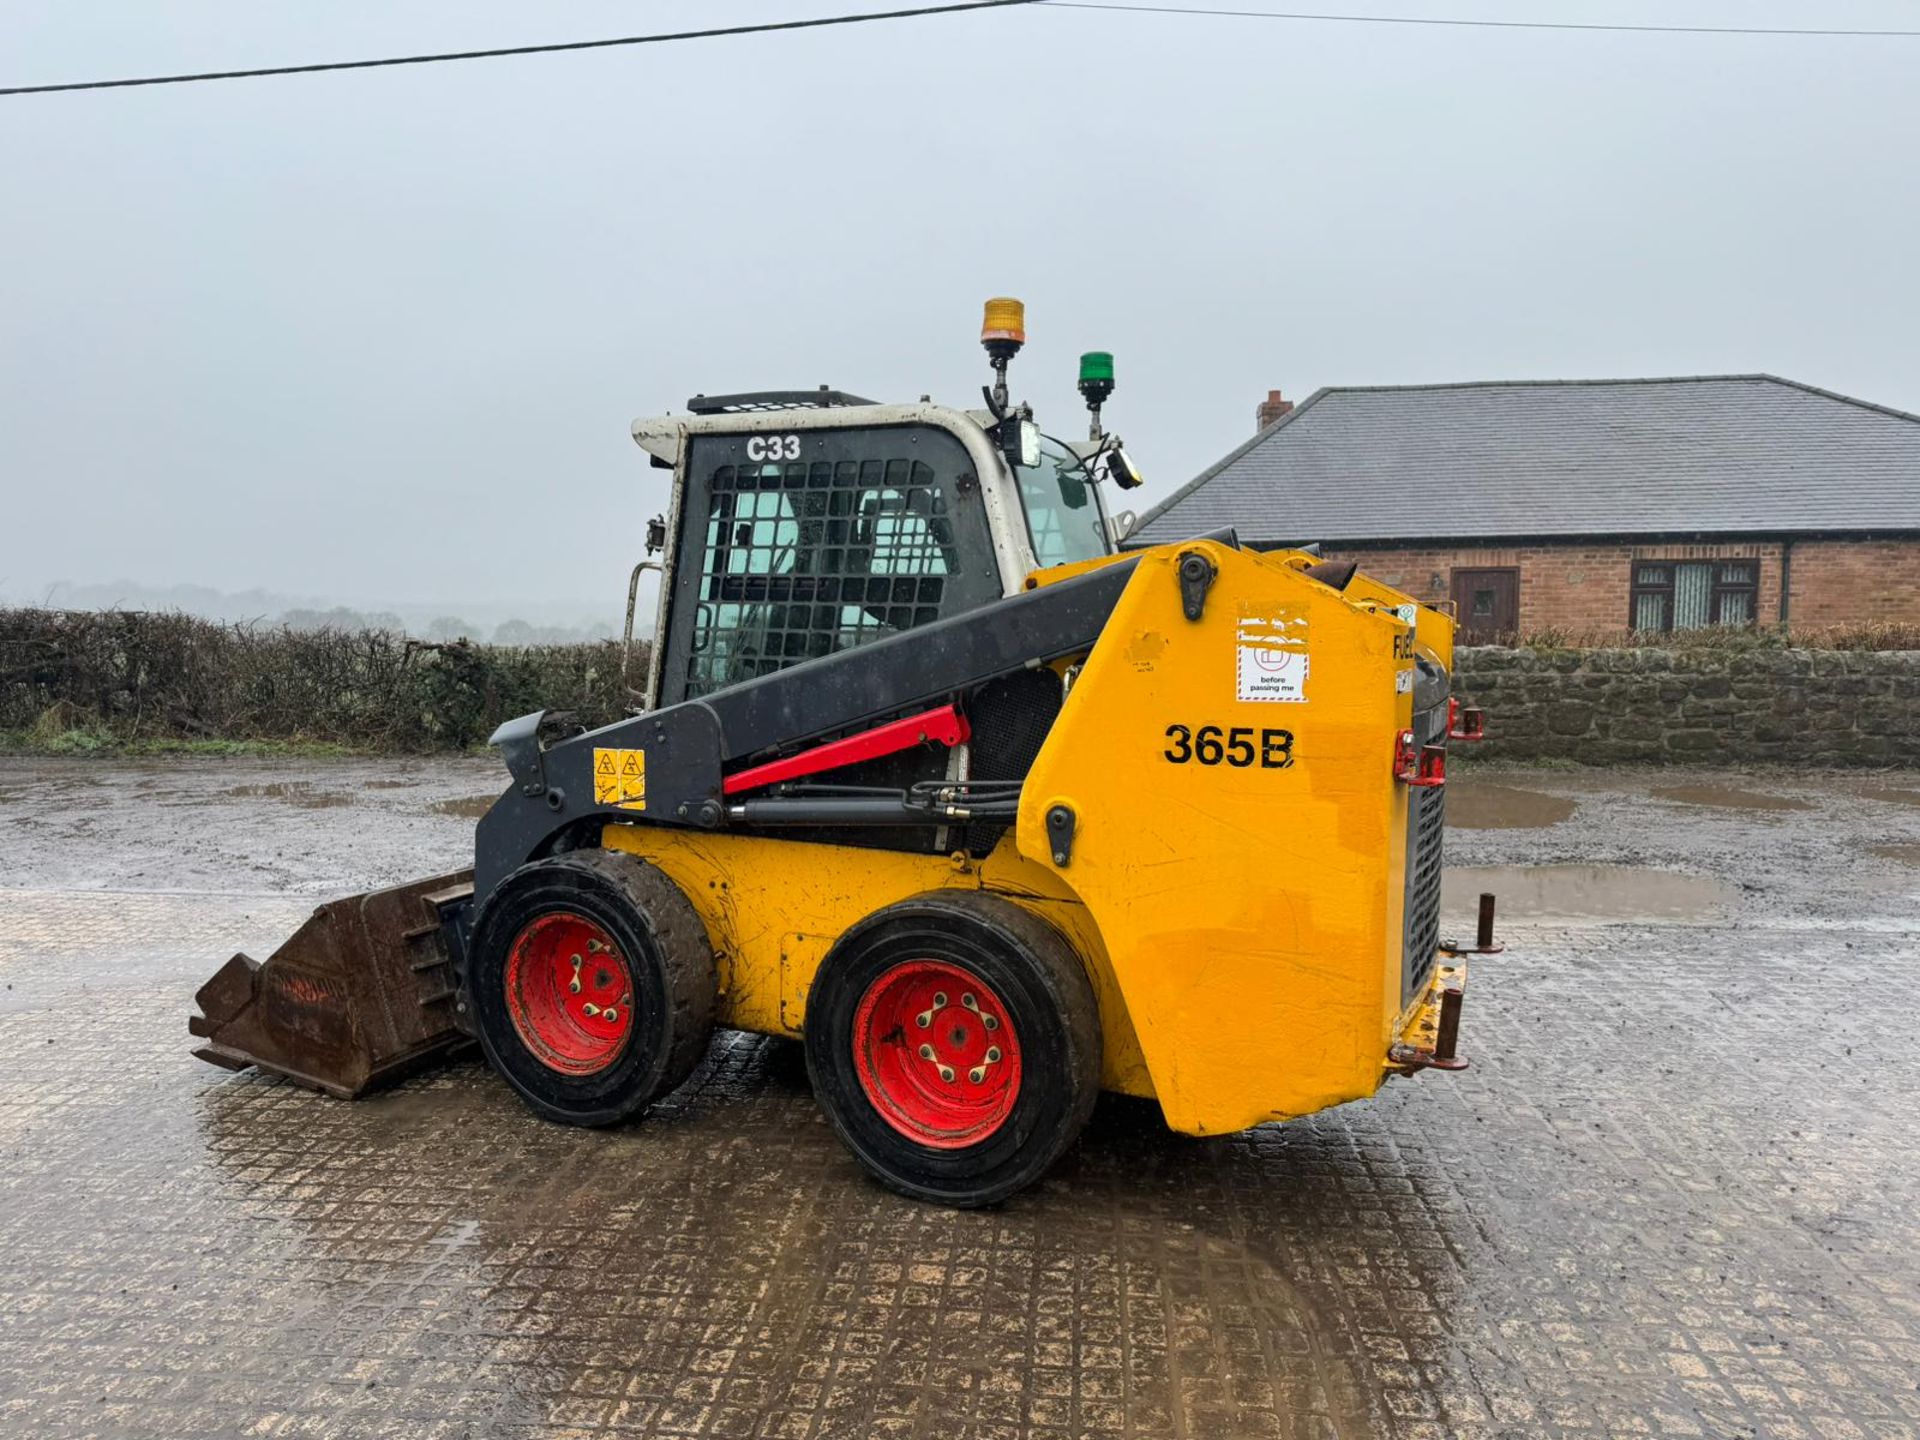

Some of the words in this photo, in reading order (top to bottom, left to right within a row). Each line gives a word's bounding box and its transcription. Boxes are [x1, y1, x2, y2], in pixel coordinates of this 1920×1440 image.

[746, 434, 801, 462] C33
[1260, 676, 1286, 684] before
[1163, 724, 1295, 769] 365B
